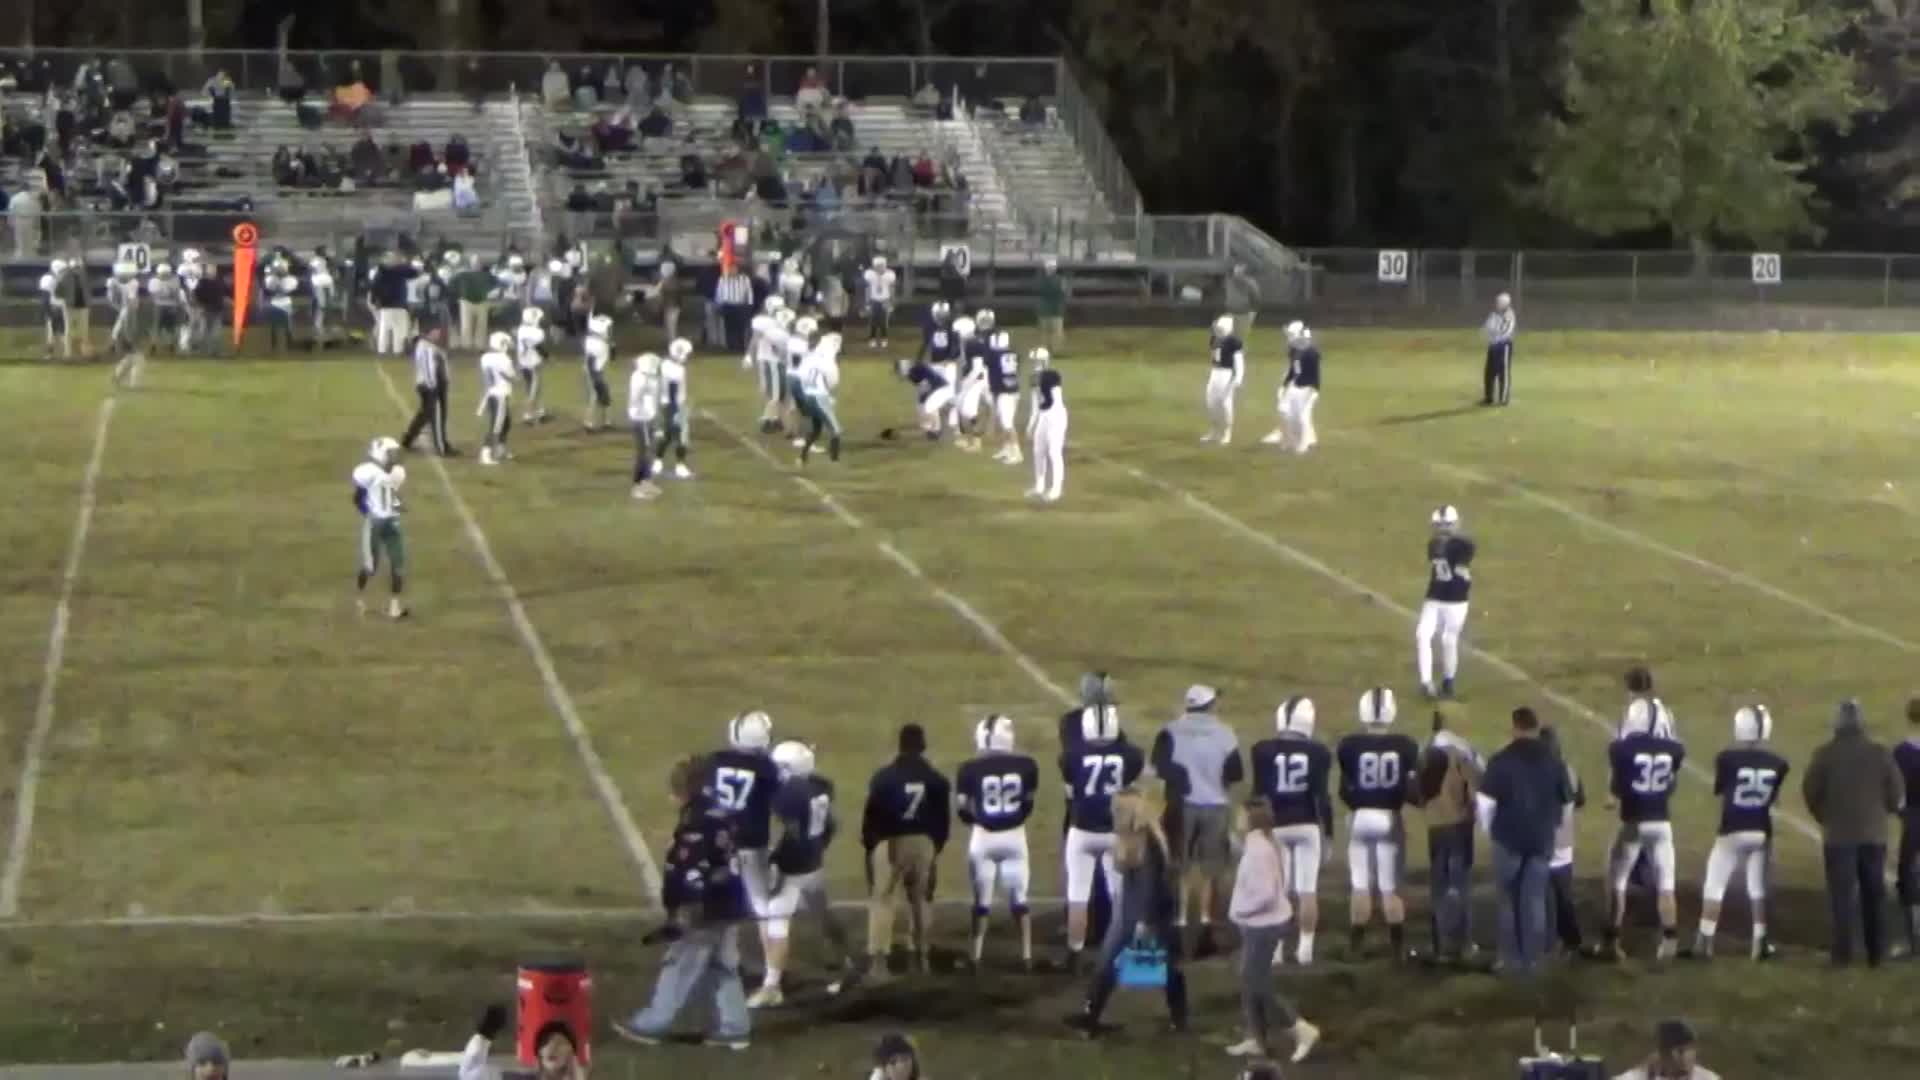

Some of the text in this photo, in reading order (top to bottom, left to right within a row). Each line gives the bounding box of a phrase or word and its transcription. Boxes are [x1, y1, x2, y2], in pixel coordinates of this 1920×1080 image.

[1382, 254, 1405, 275] 30
[1755, 257, 1777, 278] 20
[716, 767, 755, 811] 57
[1082, 754, 1124, 796] 73
[1274, 752, 1309, 793] 12
[1359, 751, 1400, 789] 80
[1631, 752, 1673, 793] 32
[1732, 766, 1777, 808] 25
[903, 782, 925, 820] 7
[981, 773, 1022, 815] 82
